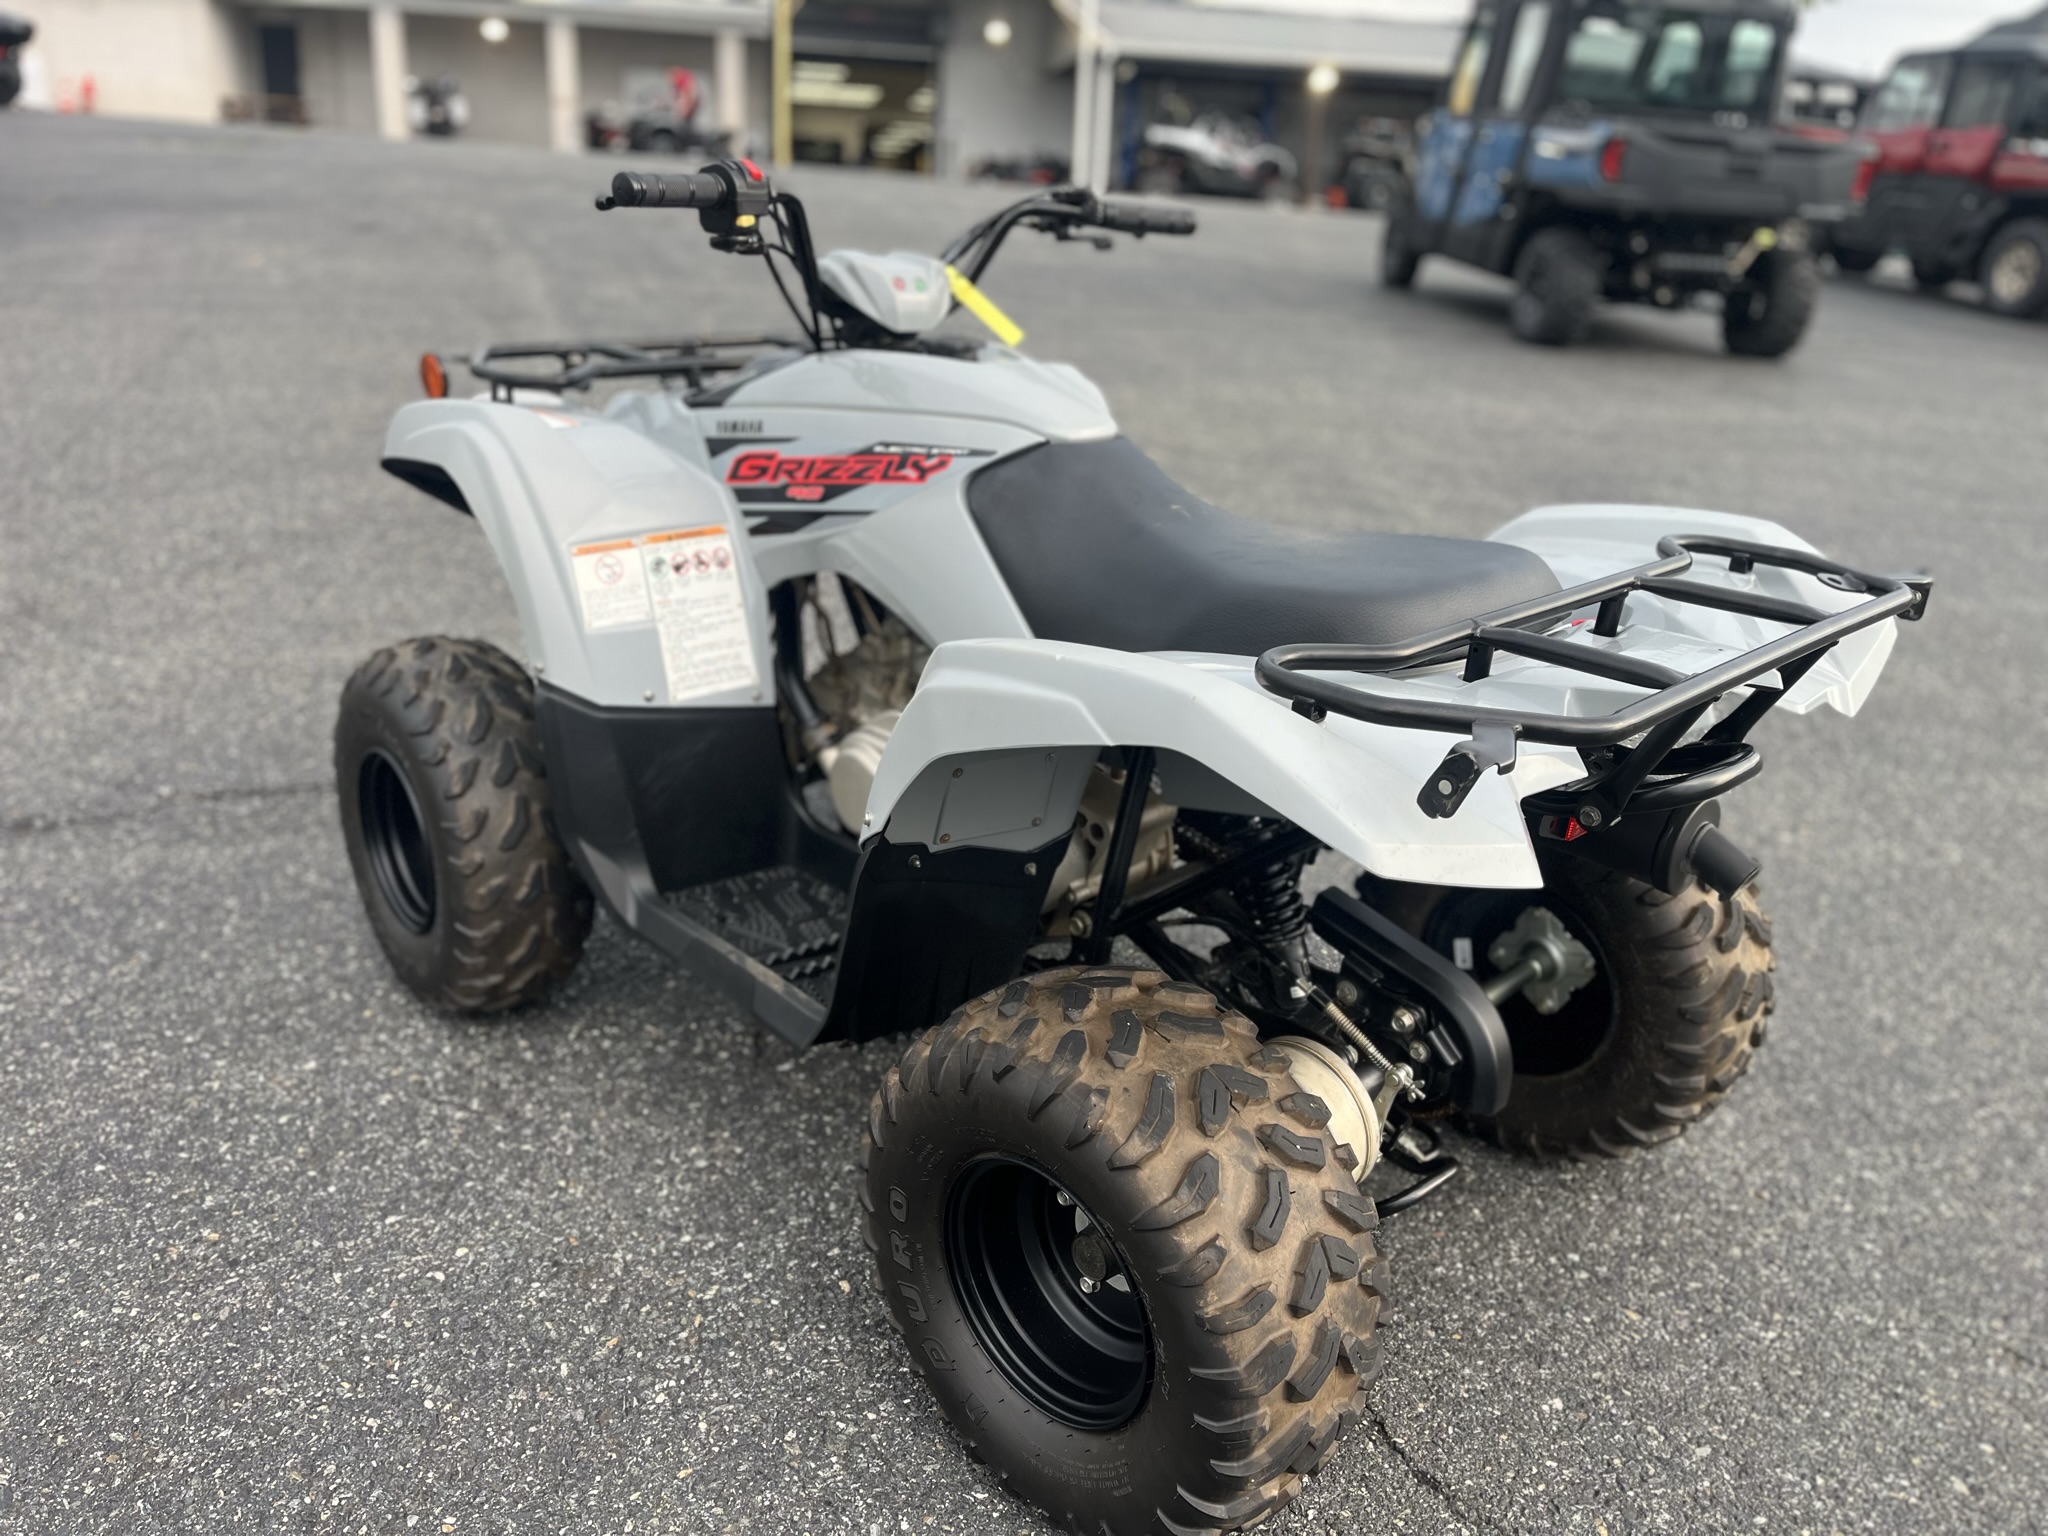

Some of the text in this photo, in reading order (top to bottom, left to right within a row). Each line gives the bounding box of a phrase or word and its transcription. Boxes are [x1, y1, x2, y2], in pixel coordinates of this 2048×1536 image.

[716, 420, 764, 433] YAMAHA
[725, 451, 954, 486] GRIZZLY
[889, 1186, 957, 1372] DURO
